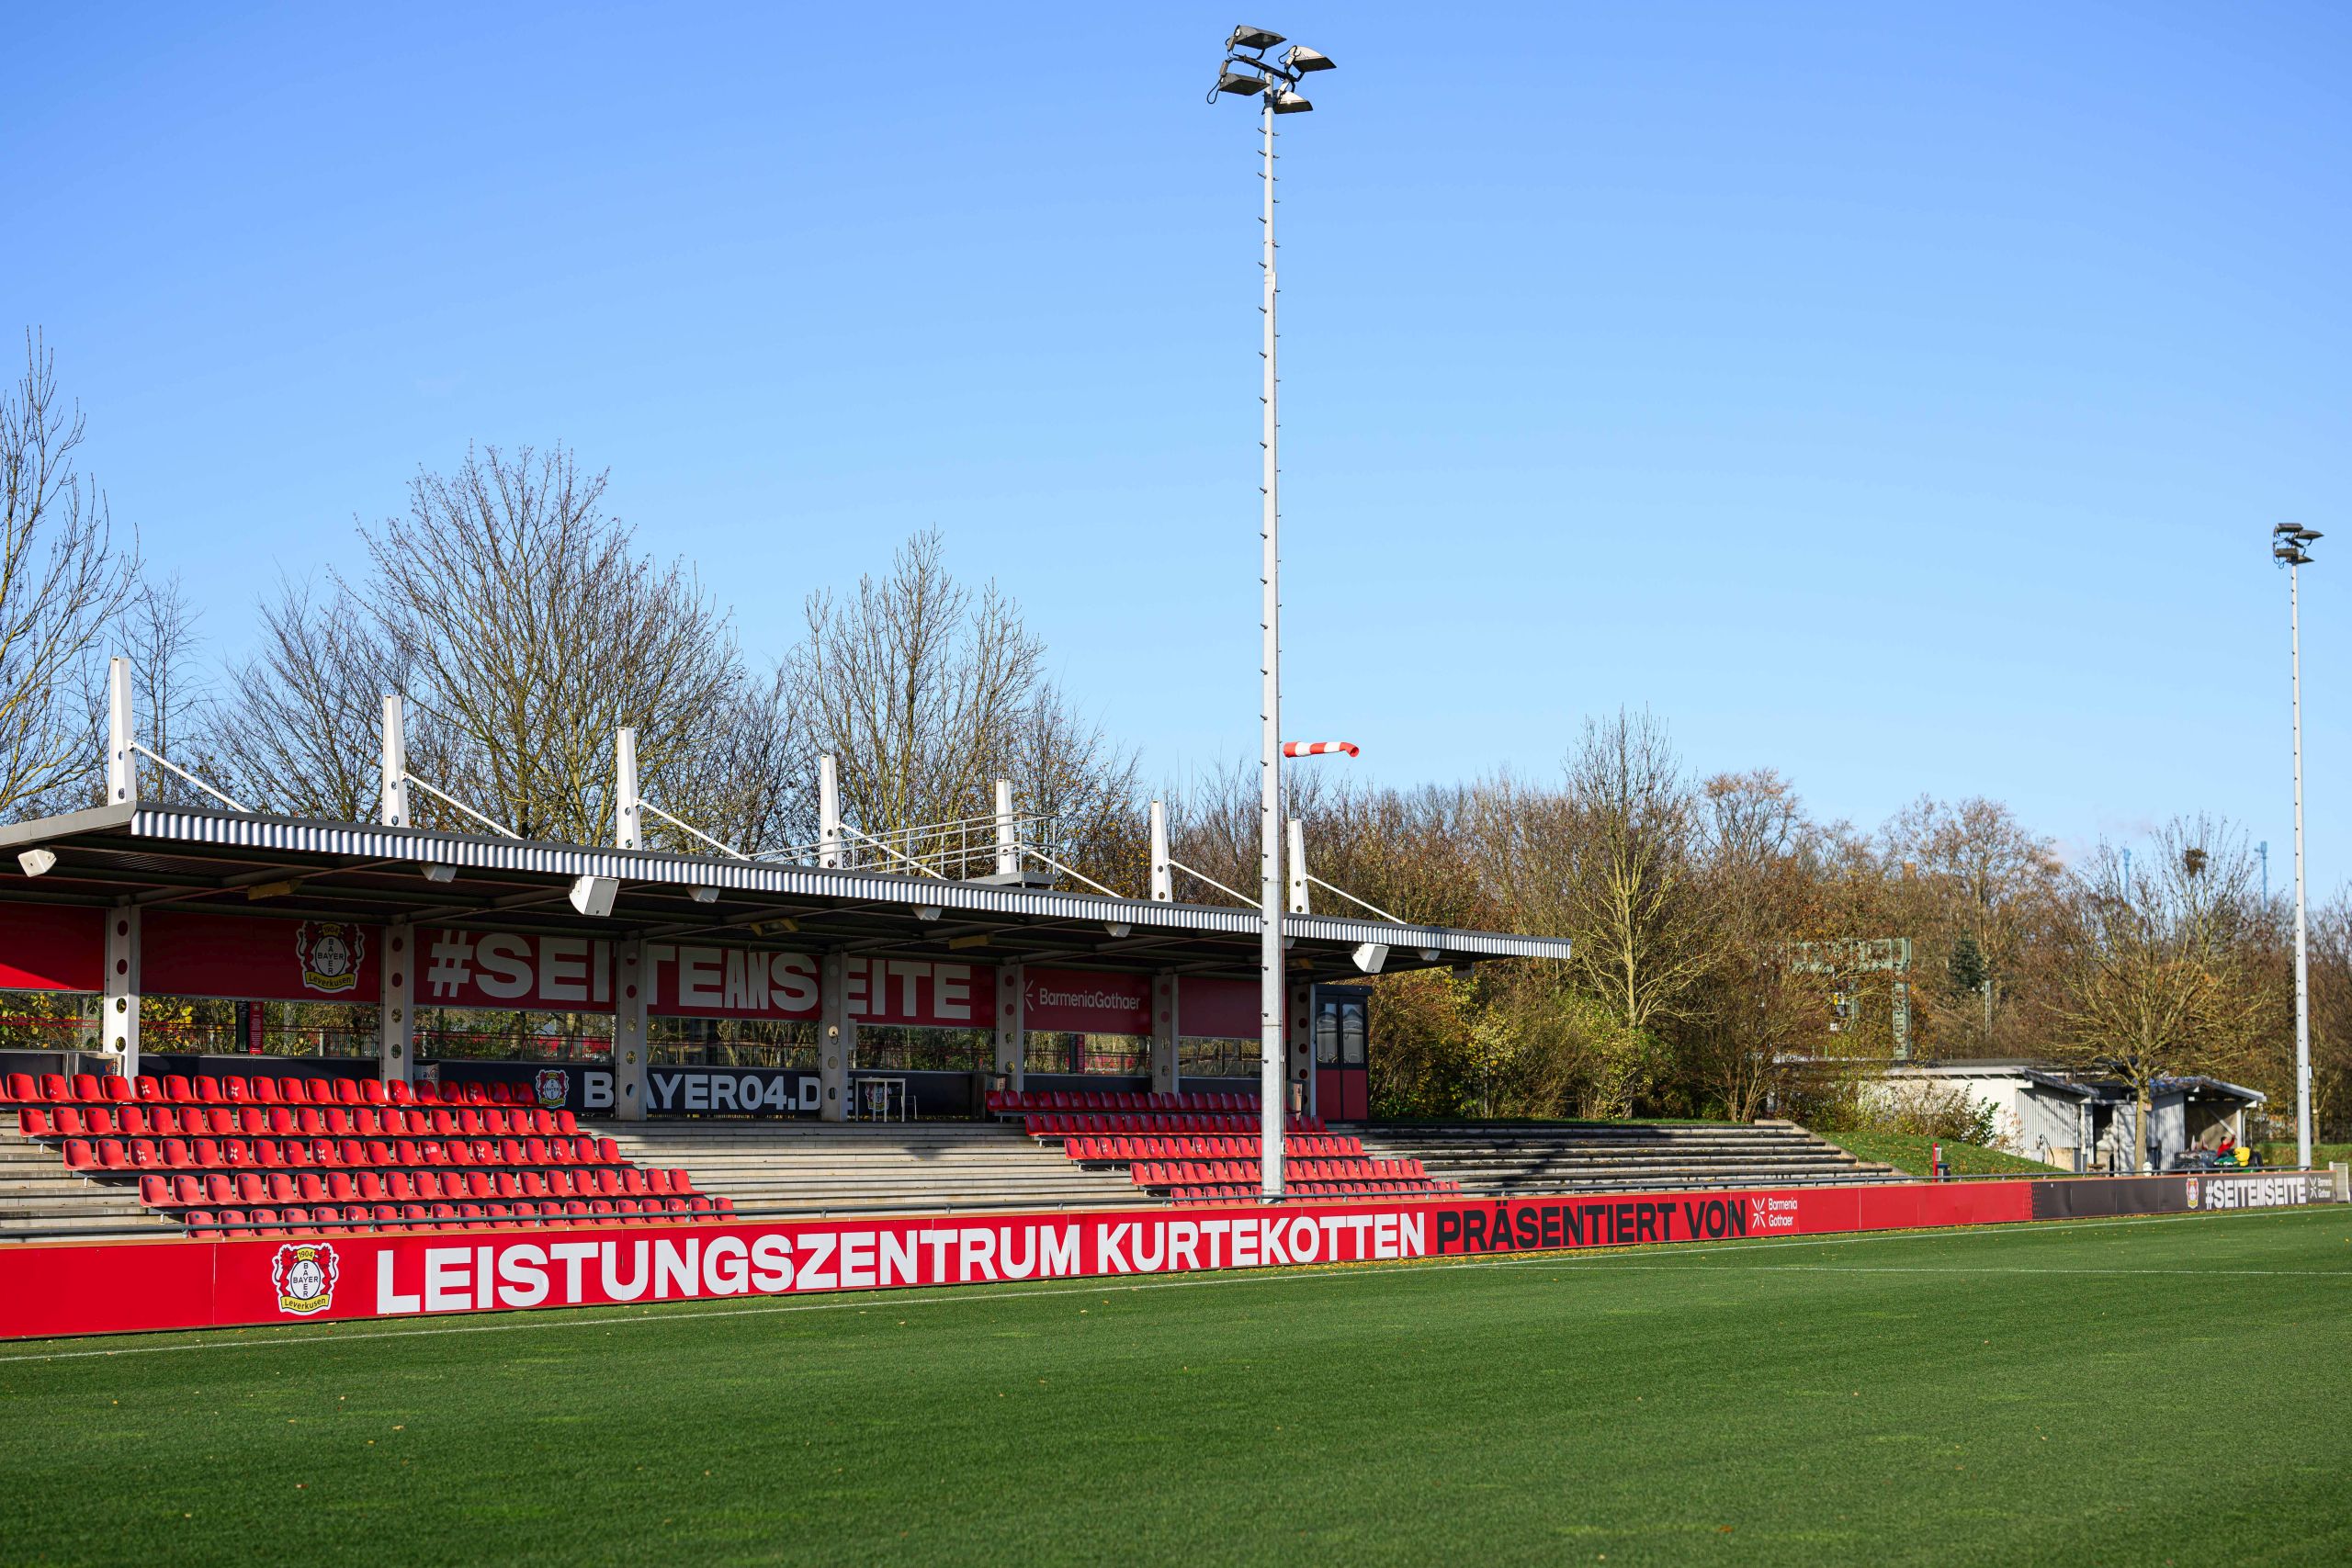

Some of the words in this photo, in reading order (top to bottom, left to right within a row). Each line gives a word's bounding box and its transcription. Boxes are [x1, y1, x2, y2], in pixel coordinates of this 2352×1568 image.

[309, 974, 351, 987] Leverkusen
[1039, 987, 1140, 1010] BarmeniaGothaer
[583, 1071, 854, 1111] BYER04.D
[1768, 1197, 1798, 1211] Barmenia
[1769, 1213, 1793, 1227] Gothaer
[299, 1250, 313, 1258] 1904
[377, 1224, 1080, 1314] LEISTUNGSZENTRUM
[1097, 1213, 1425, 1274] KURTEKOTTEN
[1437, 1200, 1676, 1254] PRÄSENTIERT
[1684, 1199, 1746, 1239] VON
[285, 1298, 325, 1309] Leverkusen
